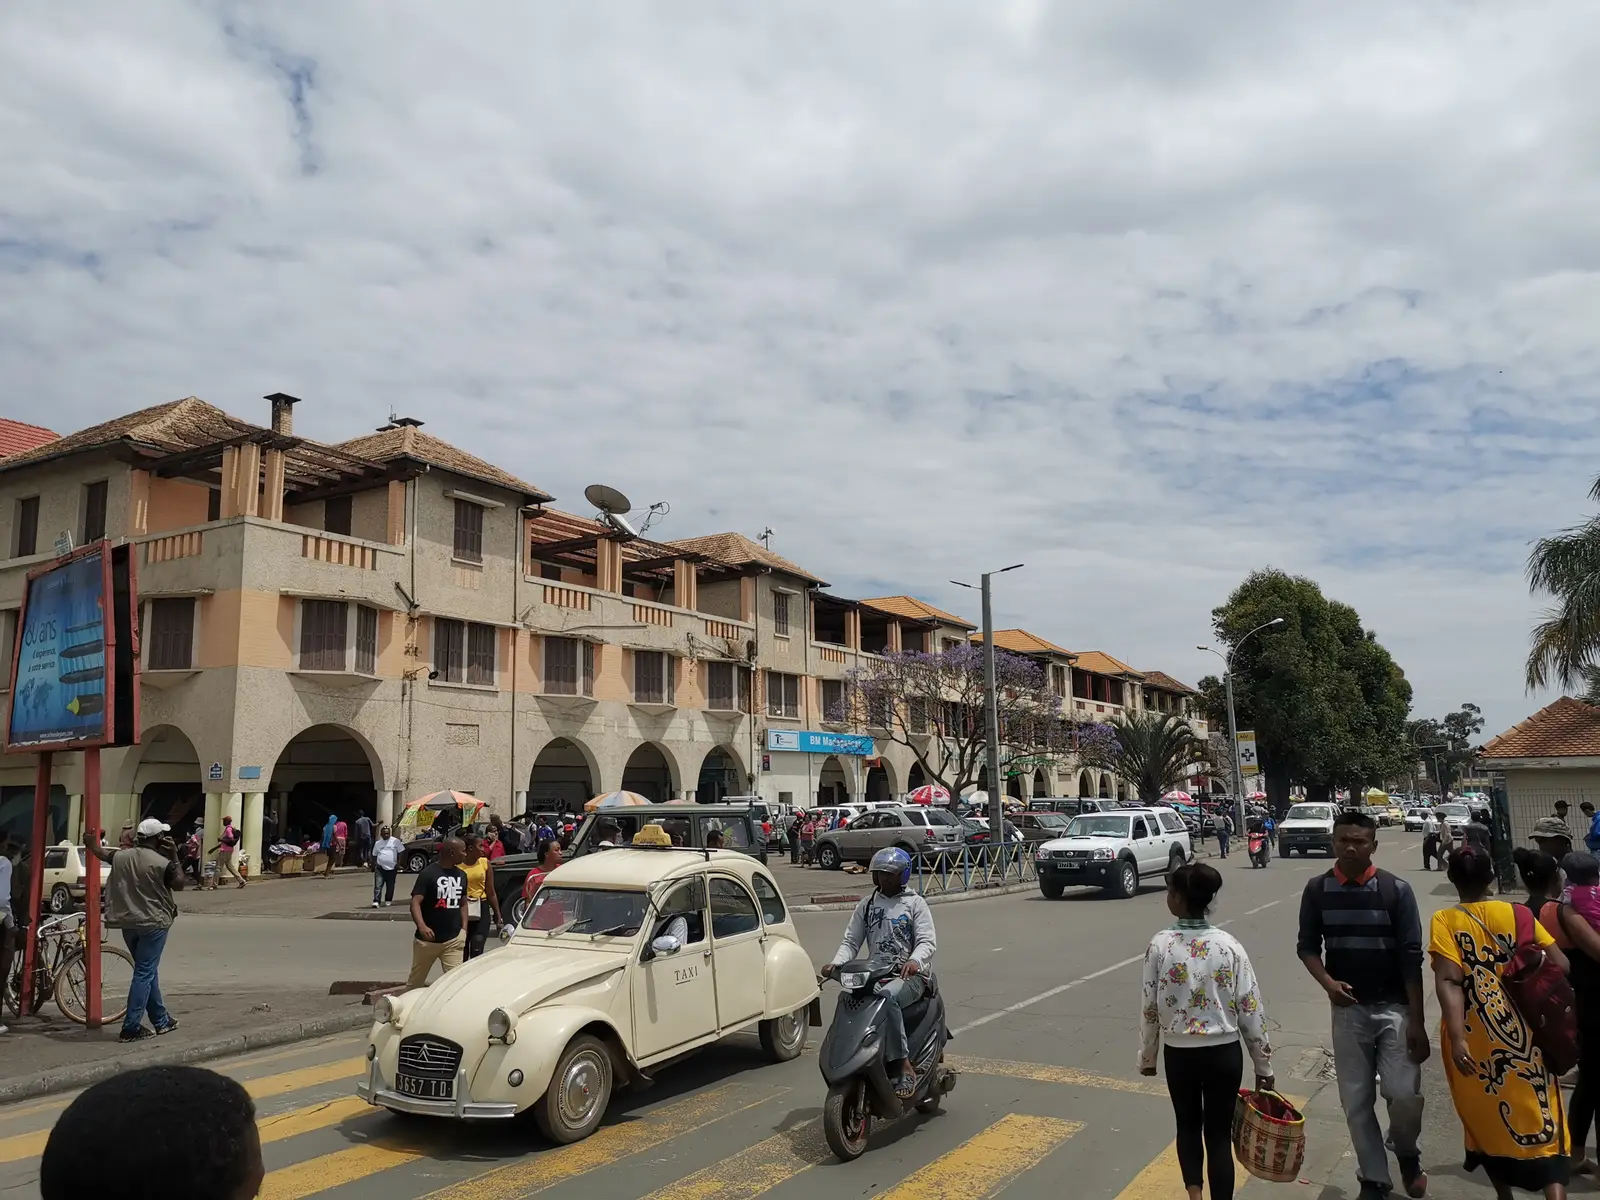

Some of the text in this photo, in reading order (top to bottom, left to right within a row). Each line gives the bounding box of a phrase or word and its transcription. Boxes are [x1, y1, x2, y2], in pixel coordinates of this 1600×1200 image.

[39, 619, 57, 644] ans
[809, 735, 821, 745] BM
[674, 965, 698, 981] TAXI
